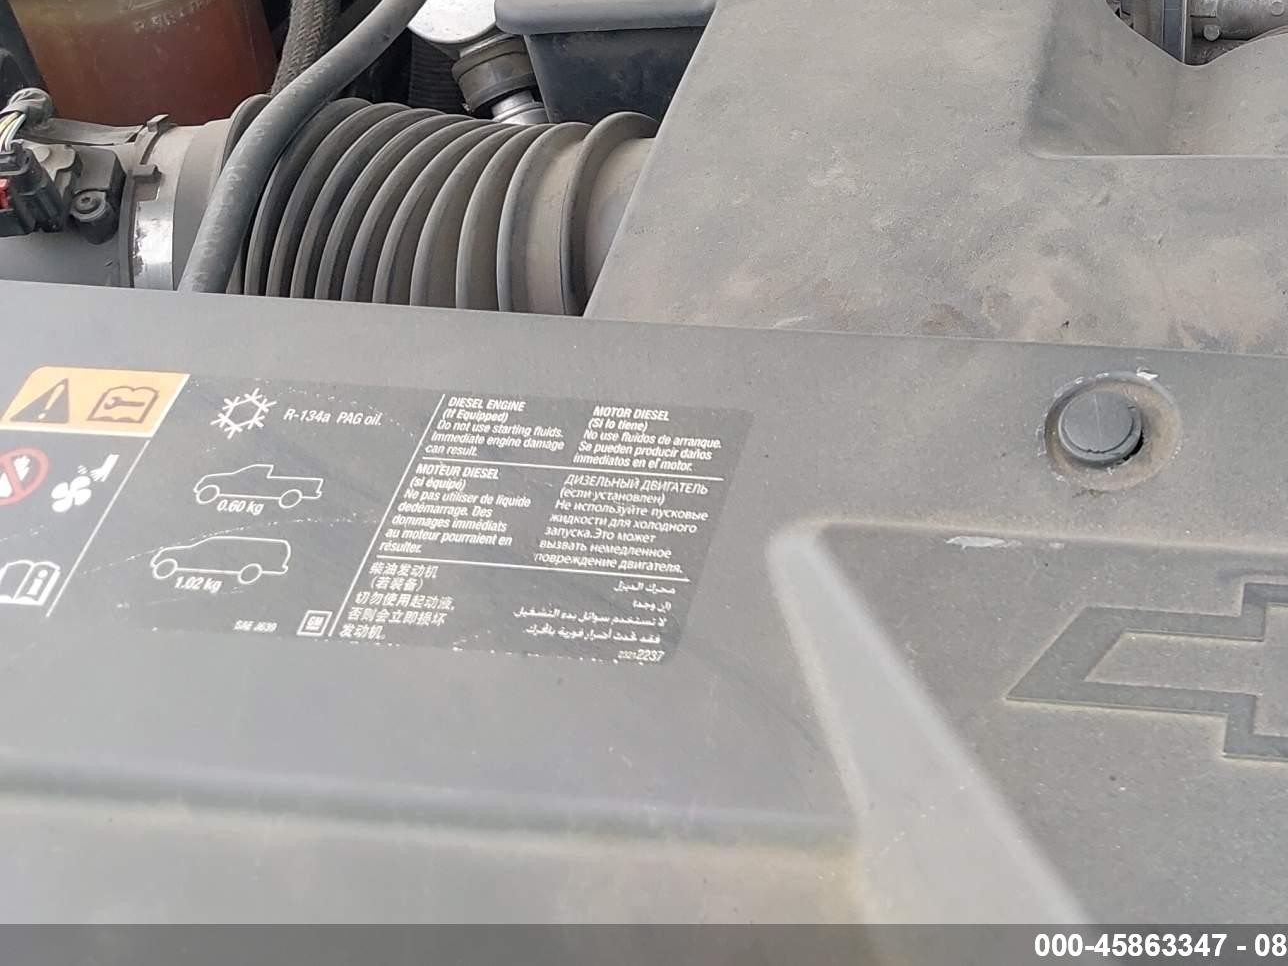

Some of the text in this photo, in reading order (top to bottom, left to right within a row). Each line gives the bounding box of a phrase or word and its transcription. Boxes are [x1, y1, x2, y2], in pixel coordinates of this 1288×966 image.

[448, 397, 526, 411] DIESEL ENGINE
[283, 408, 382, 426] R-134a PAG oil.
[456, 409, 509, 423] Equipped)
[593, 406, 670, 421] MOTOR DIESEL
[437, 420, 564, 438] Do not use starting fluids.
[605, 419, 616, 429] lo
[618, 419, 648, 432] tiene)
[486, 436, 522, 448] engine
[523, 438, 565, 452] damage
[583, 429, 722, 449] No use fluidos de arranque.
[425, 444, 478, 456] can result.
[578, 441, 713, 460] Se pueden producir daños
[415, 463, 500, 480] MOTEUR DIESEL
[632, 459, 646, 468] en
[660, 461, 693, 472] motor.
[564, 474, 708, 495] ДИЗЕЛЬНЫЙ ДВИГАТЕЛЬ
[403, 488, 531, 508] Ne pas utiliser de liquide
[559, 487, 666, 506] (если установлен)
[217, 499, 264, 515] 0.60 kg
[472, 506, 493, 518] Des
[555, 499, 709, 521] Не используйте пусковые
[392, 514, 508, 532] dommages immédiats
[549, 514, 697, 533] жидкости для холодного
[385, 528, 512, 546] au moteur pourraient en
[617, 532, 656, 543] может
[379, 540, 422, 553] résulter.
[539, 539, 672, 558] вызвать немедленное
[369, 561, 439, 578] 柴油发动机
[534, 553, 684, 573] повреждение двигателя.
[174, 576, 223, 594] 1.02 kg
